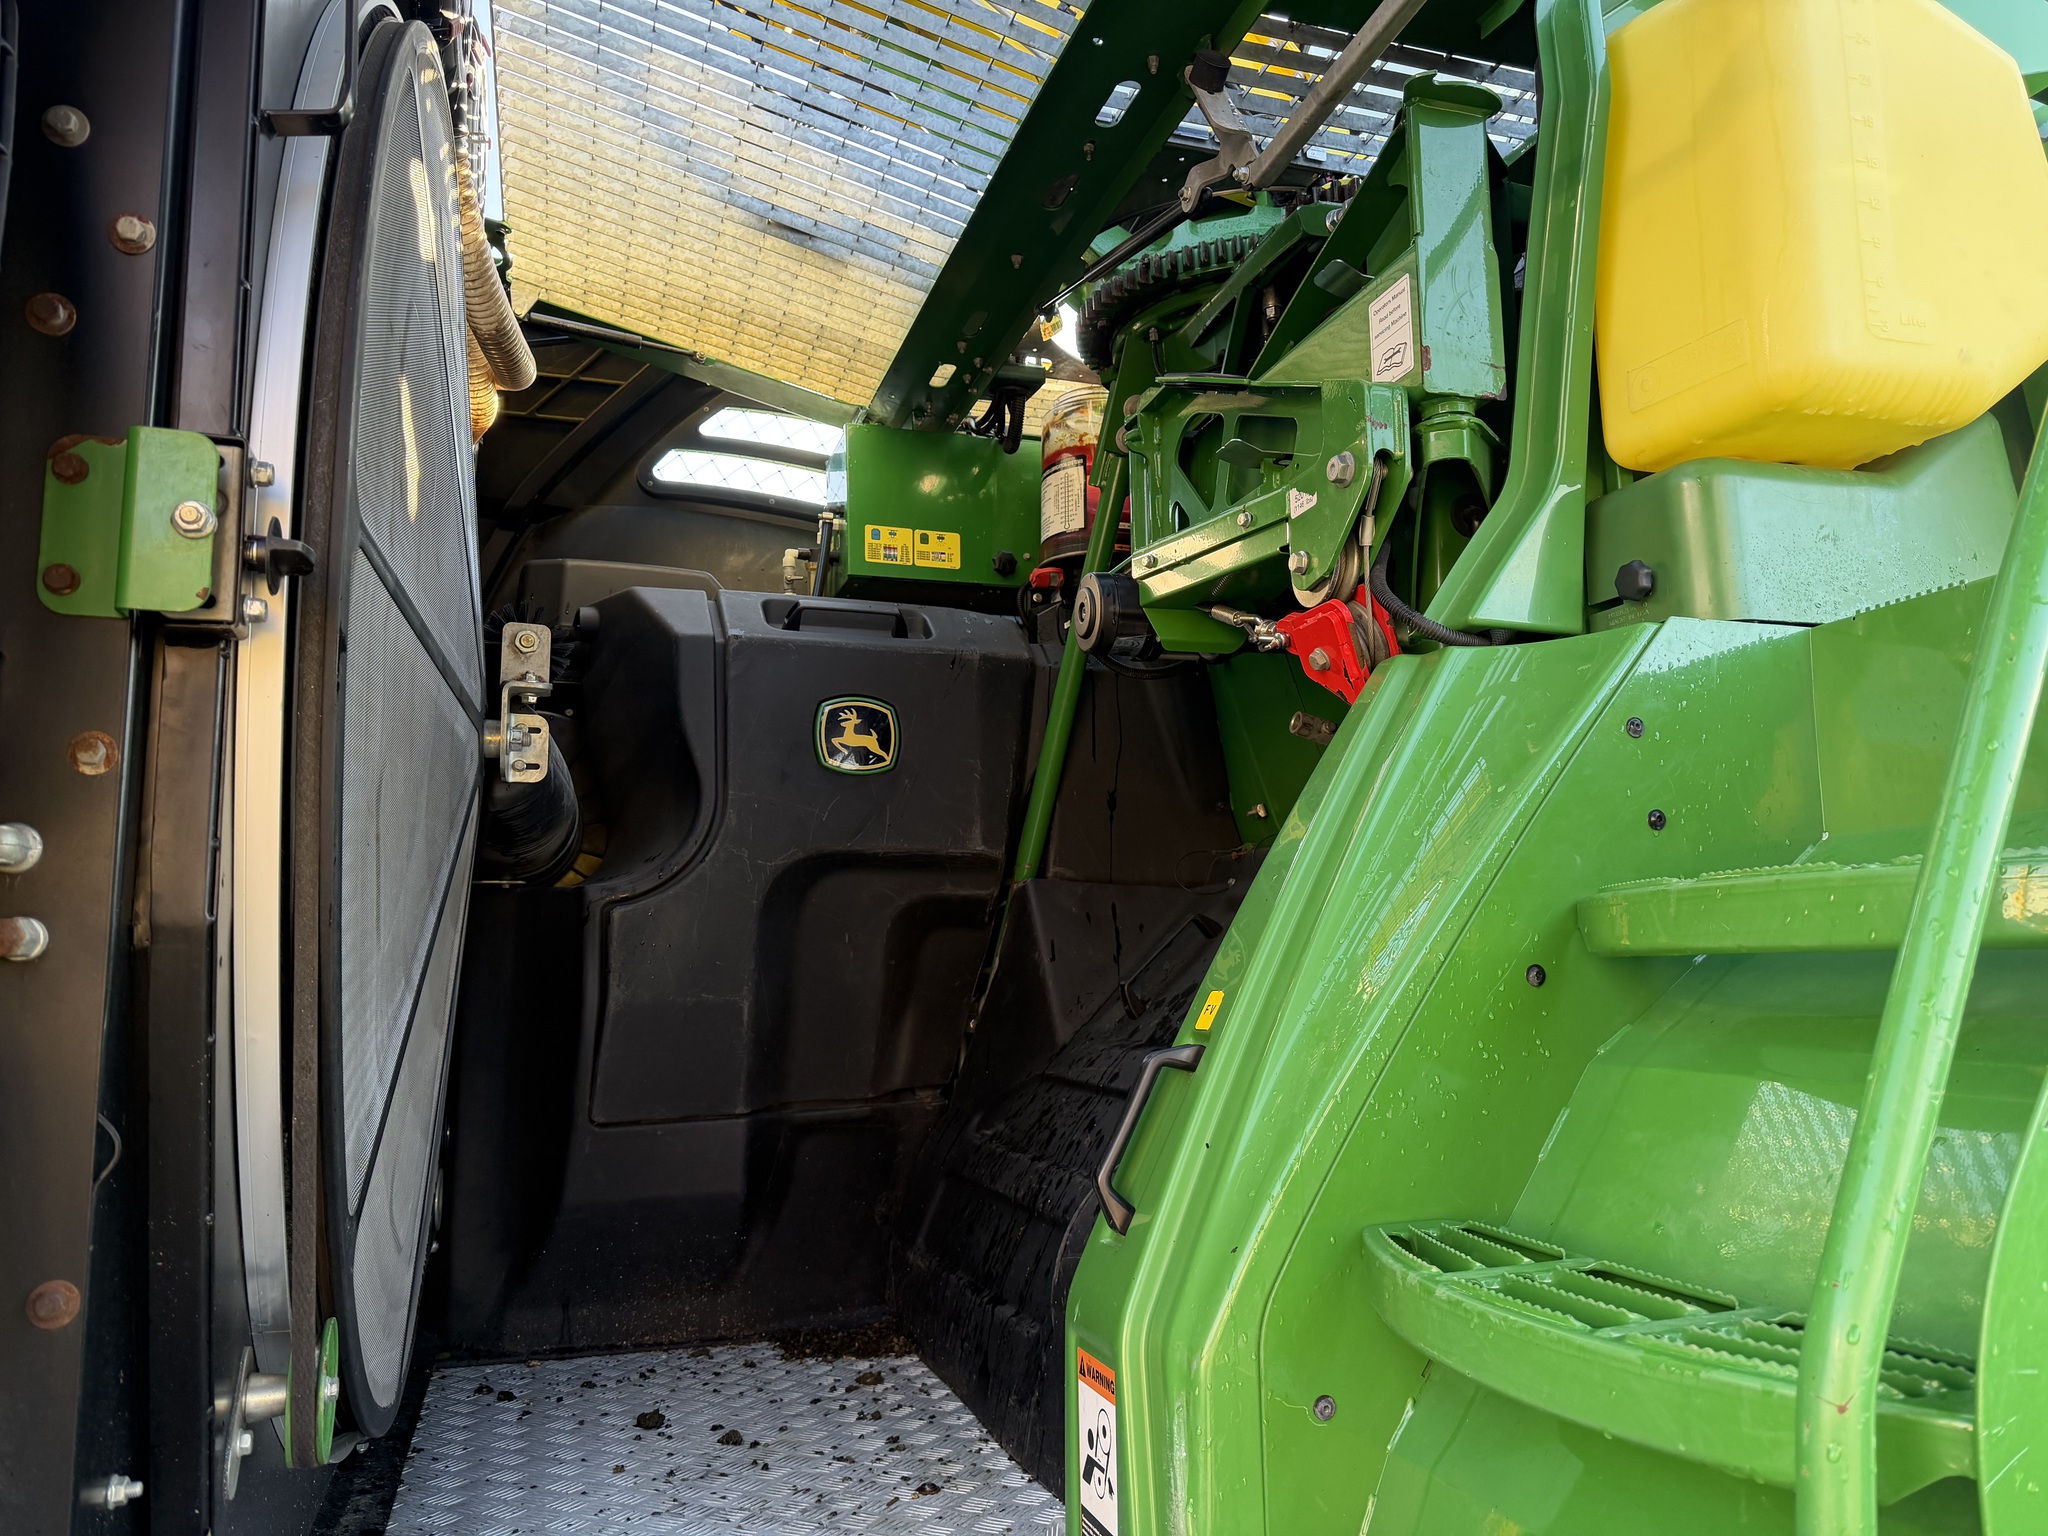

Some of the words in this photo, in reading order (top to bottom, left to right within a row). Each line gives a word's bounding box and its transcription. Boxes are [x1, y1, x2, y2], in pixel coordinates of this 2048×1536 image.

[1867, 156, 1879, 169] 15
[1871, 197, 1881, 210] 12
[1373, 299, 1392, 317] Operators
[1392, 287, 1406, 300] Manual
[1378, 313, 1389, 325] Read
[1389, 304, 1401, 316] before
[1390, 312, 1407, 327] Machine
[1900, 313, 1927, 328] Liter
[1204, 1004, 1217, 1015] FV
[1086, 1362, 1115, 1395] WARNING
